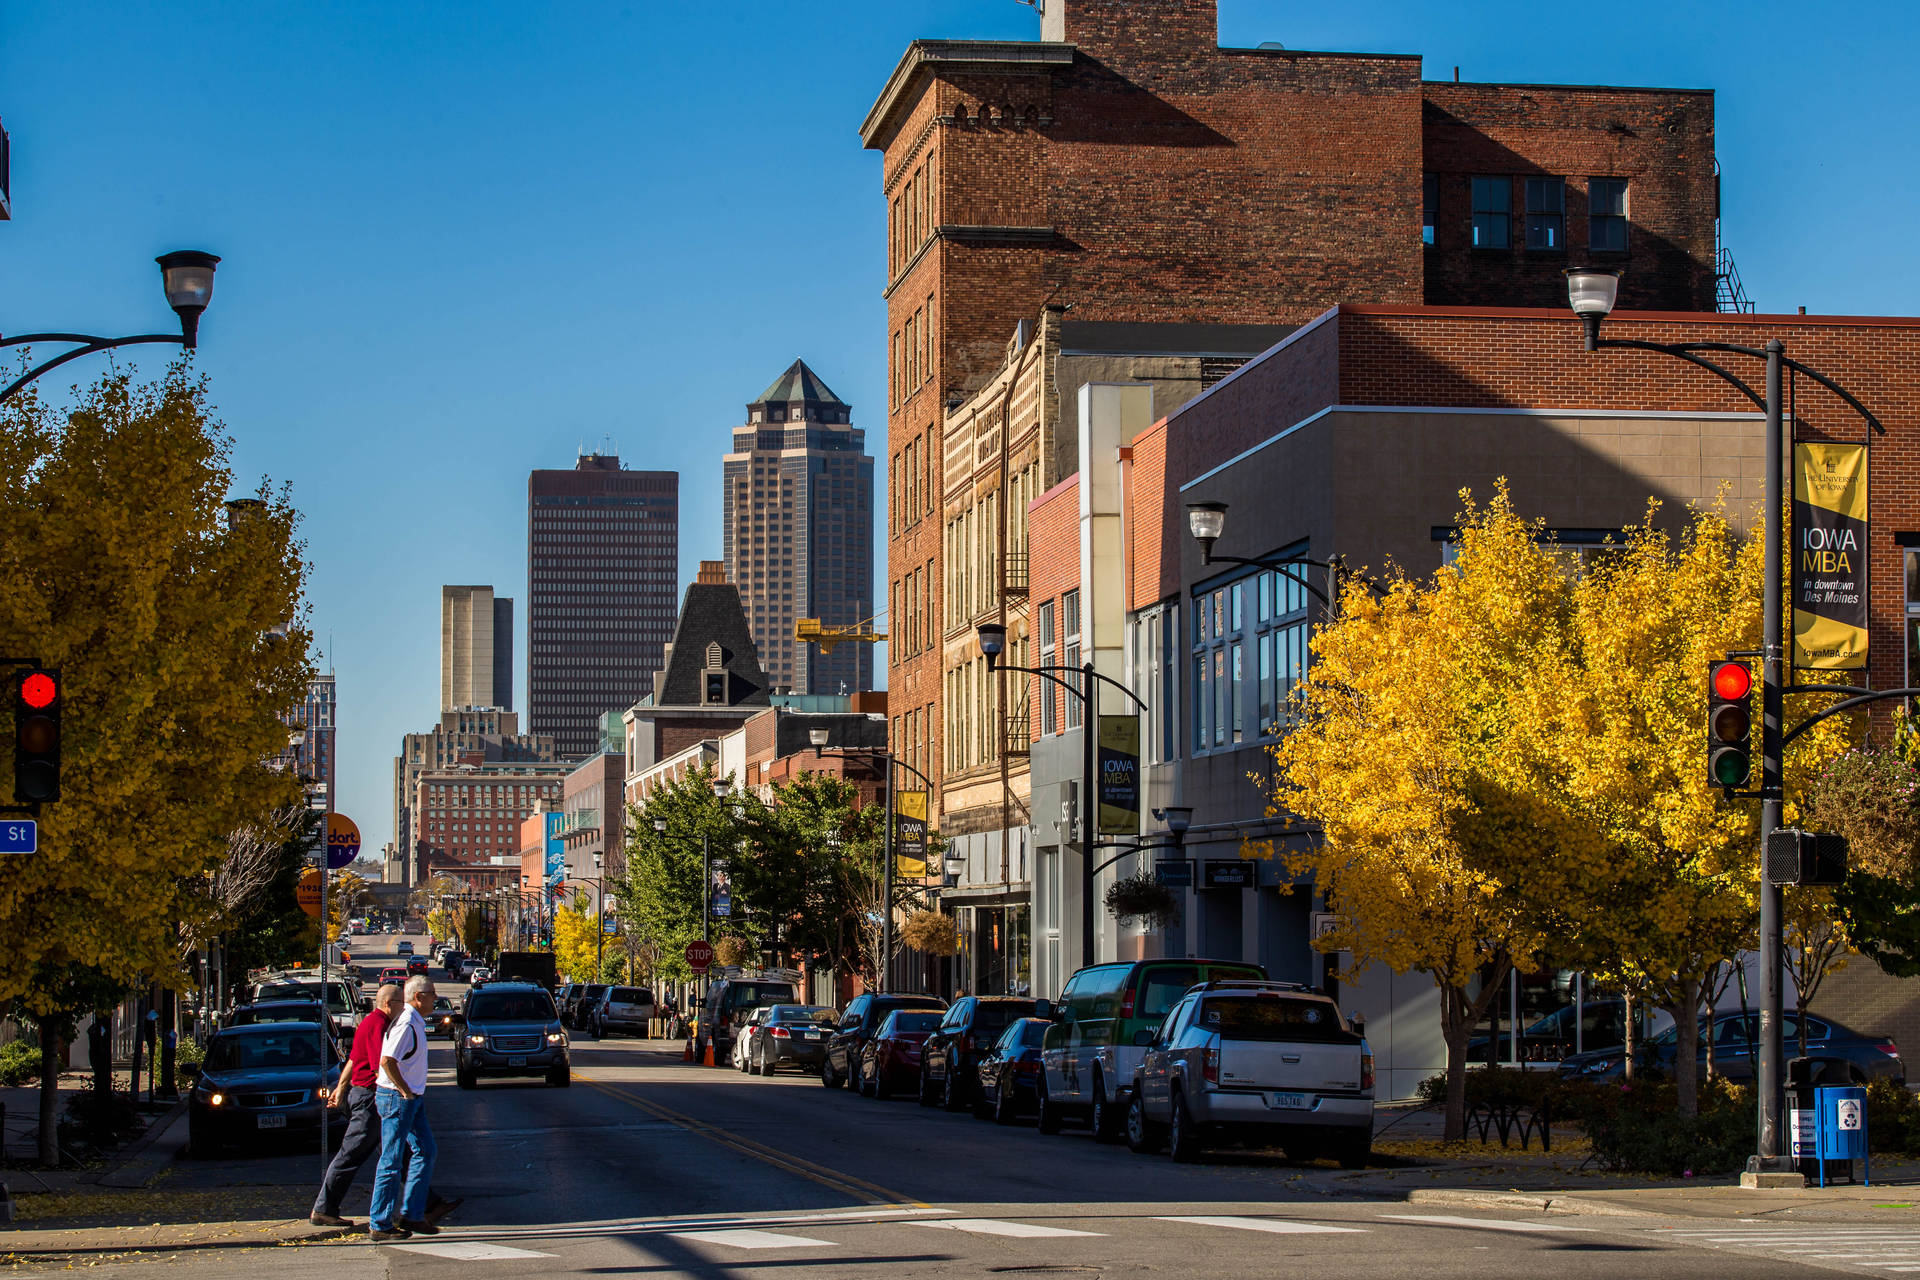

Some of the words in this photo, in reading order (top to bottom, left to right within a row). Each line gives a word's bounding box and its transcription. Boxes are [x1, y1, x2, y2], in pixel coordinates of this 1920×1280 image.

[1804, 527, 1857, 551] IOWA
[1803, 551, 1852, 574] MBA
[1804, 578, 1812, 589] in
[1815, 579, 1854, 590] downtown
[1804, 590, 1822, 603] Des
[1824, 591, 1859, 604] Moines
[1803, 648, 1860, 658] IowaMBA.com
[1104, 760, 1134, 772] IOWA
[1104, 772, 1131, 784] MBA
[8, 826, 26, 841] St
[900, 823, 923, 833] IOWA
[900, 833, 920, 841] MBA
[687, 949, 712, 960] STOP
[1519, 1045, 1566, 1058] OPEN
